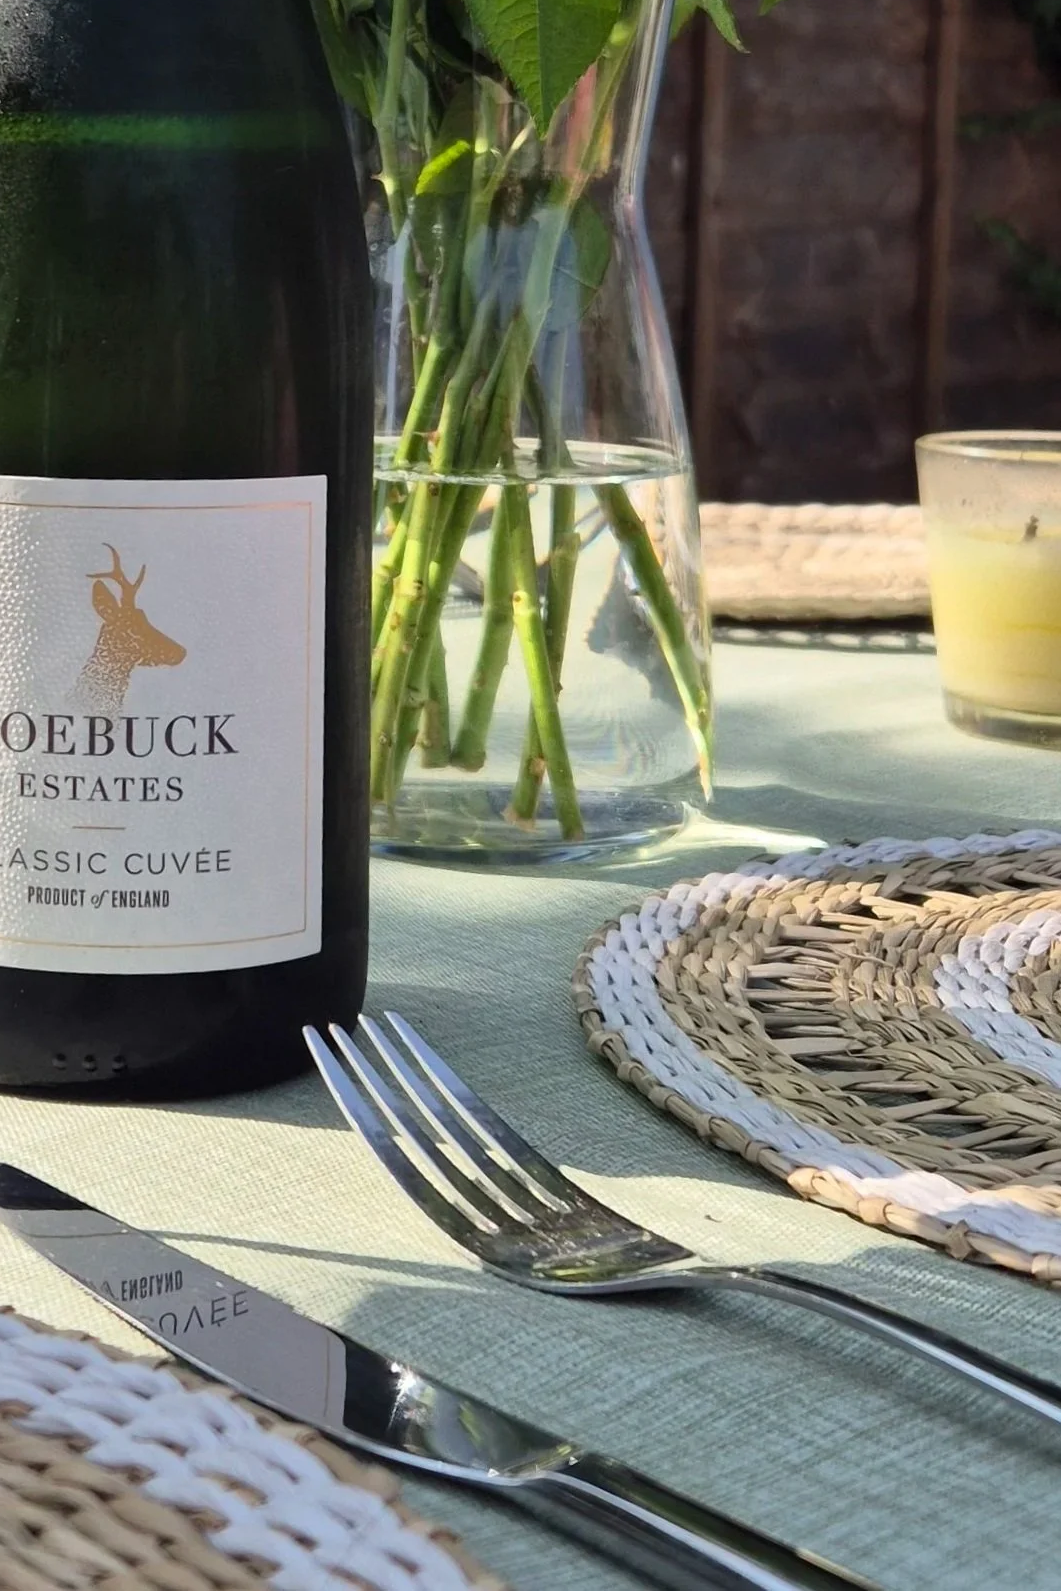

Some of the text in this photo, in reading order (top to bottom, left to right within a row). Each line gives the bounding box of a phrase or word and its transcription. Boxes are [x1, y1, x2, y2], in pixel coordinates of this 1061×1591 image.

[17, 772, 185, 802] ESTATES
[124, 847, 233, 876] CUVÉE
[27, 886, 171, 909] PRODUCT of ENGLAND
